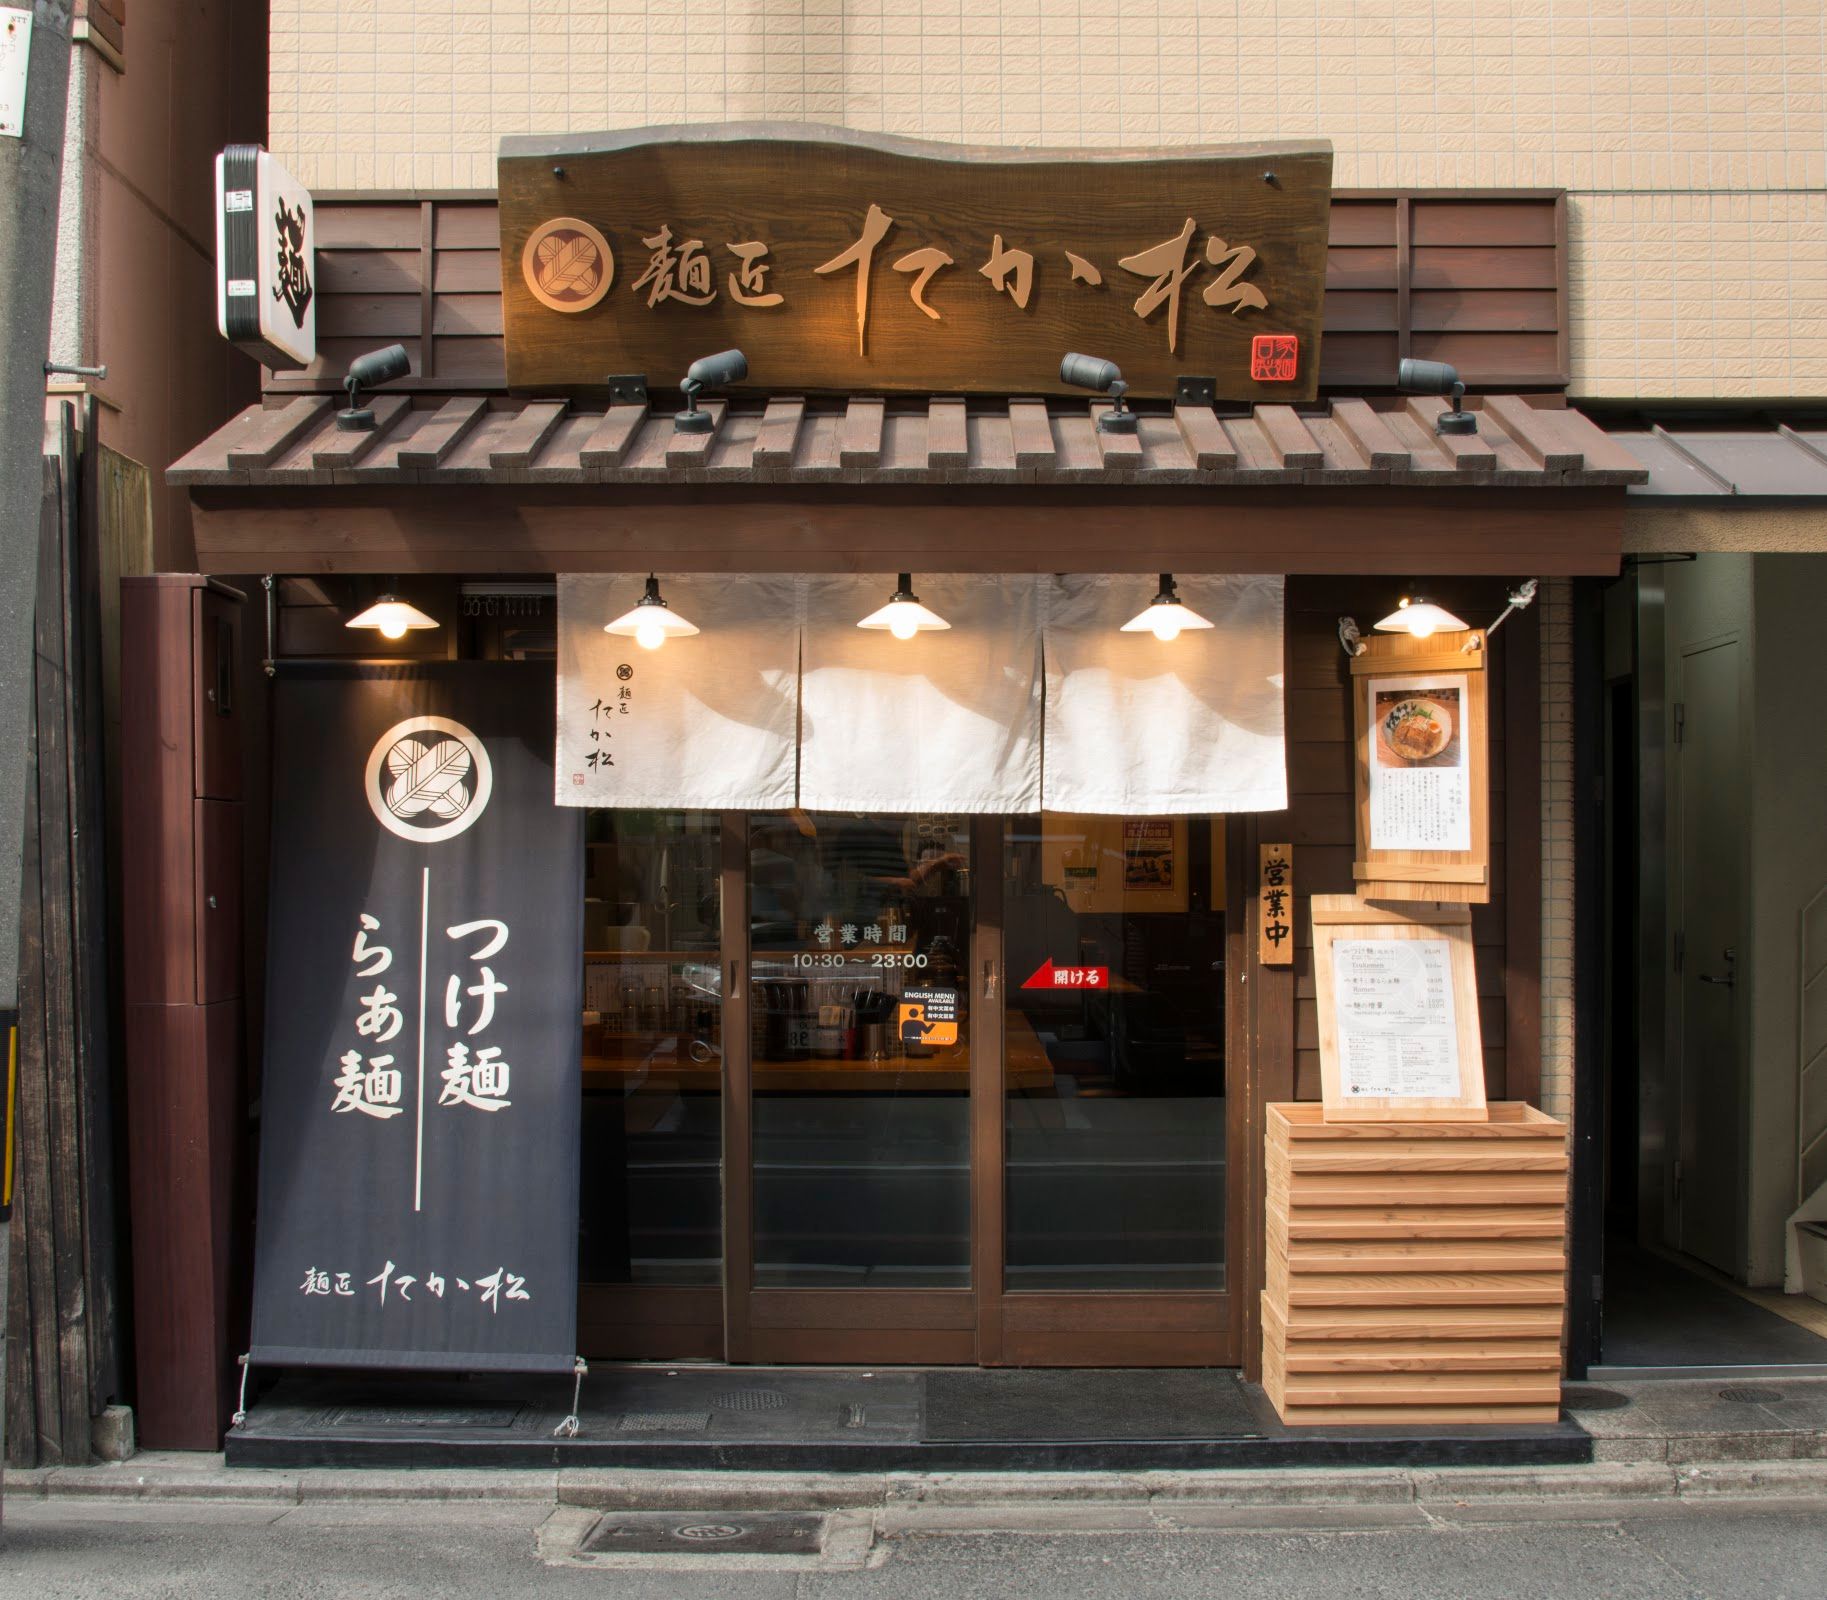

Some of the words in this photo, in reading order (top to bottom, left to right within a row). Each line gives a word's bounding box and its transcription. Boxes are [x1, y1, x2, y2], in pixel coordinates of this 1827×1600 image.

[10, 15, 28, 24] NTT
[1263, 858, 1290, 948] 営業中
[814, 923, 907, 944] 営業時間
[792, 953, 845, 968] 10:30
[871, 953, 928, 968] 23:00
[1054, 969, 1100, 985] 開ける
[904, 991, 933, 999] ENGLISH
[438, 918, 511, 1111] つけ麺
